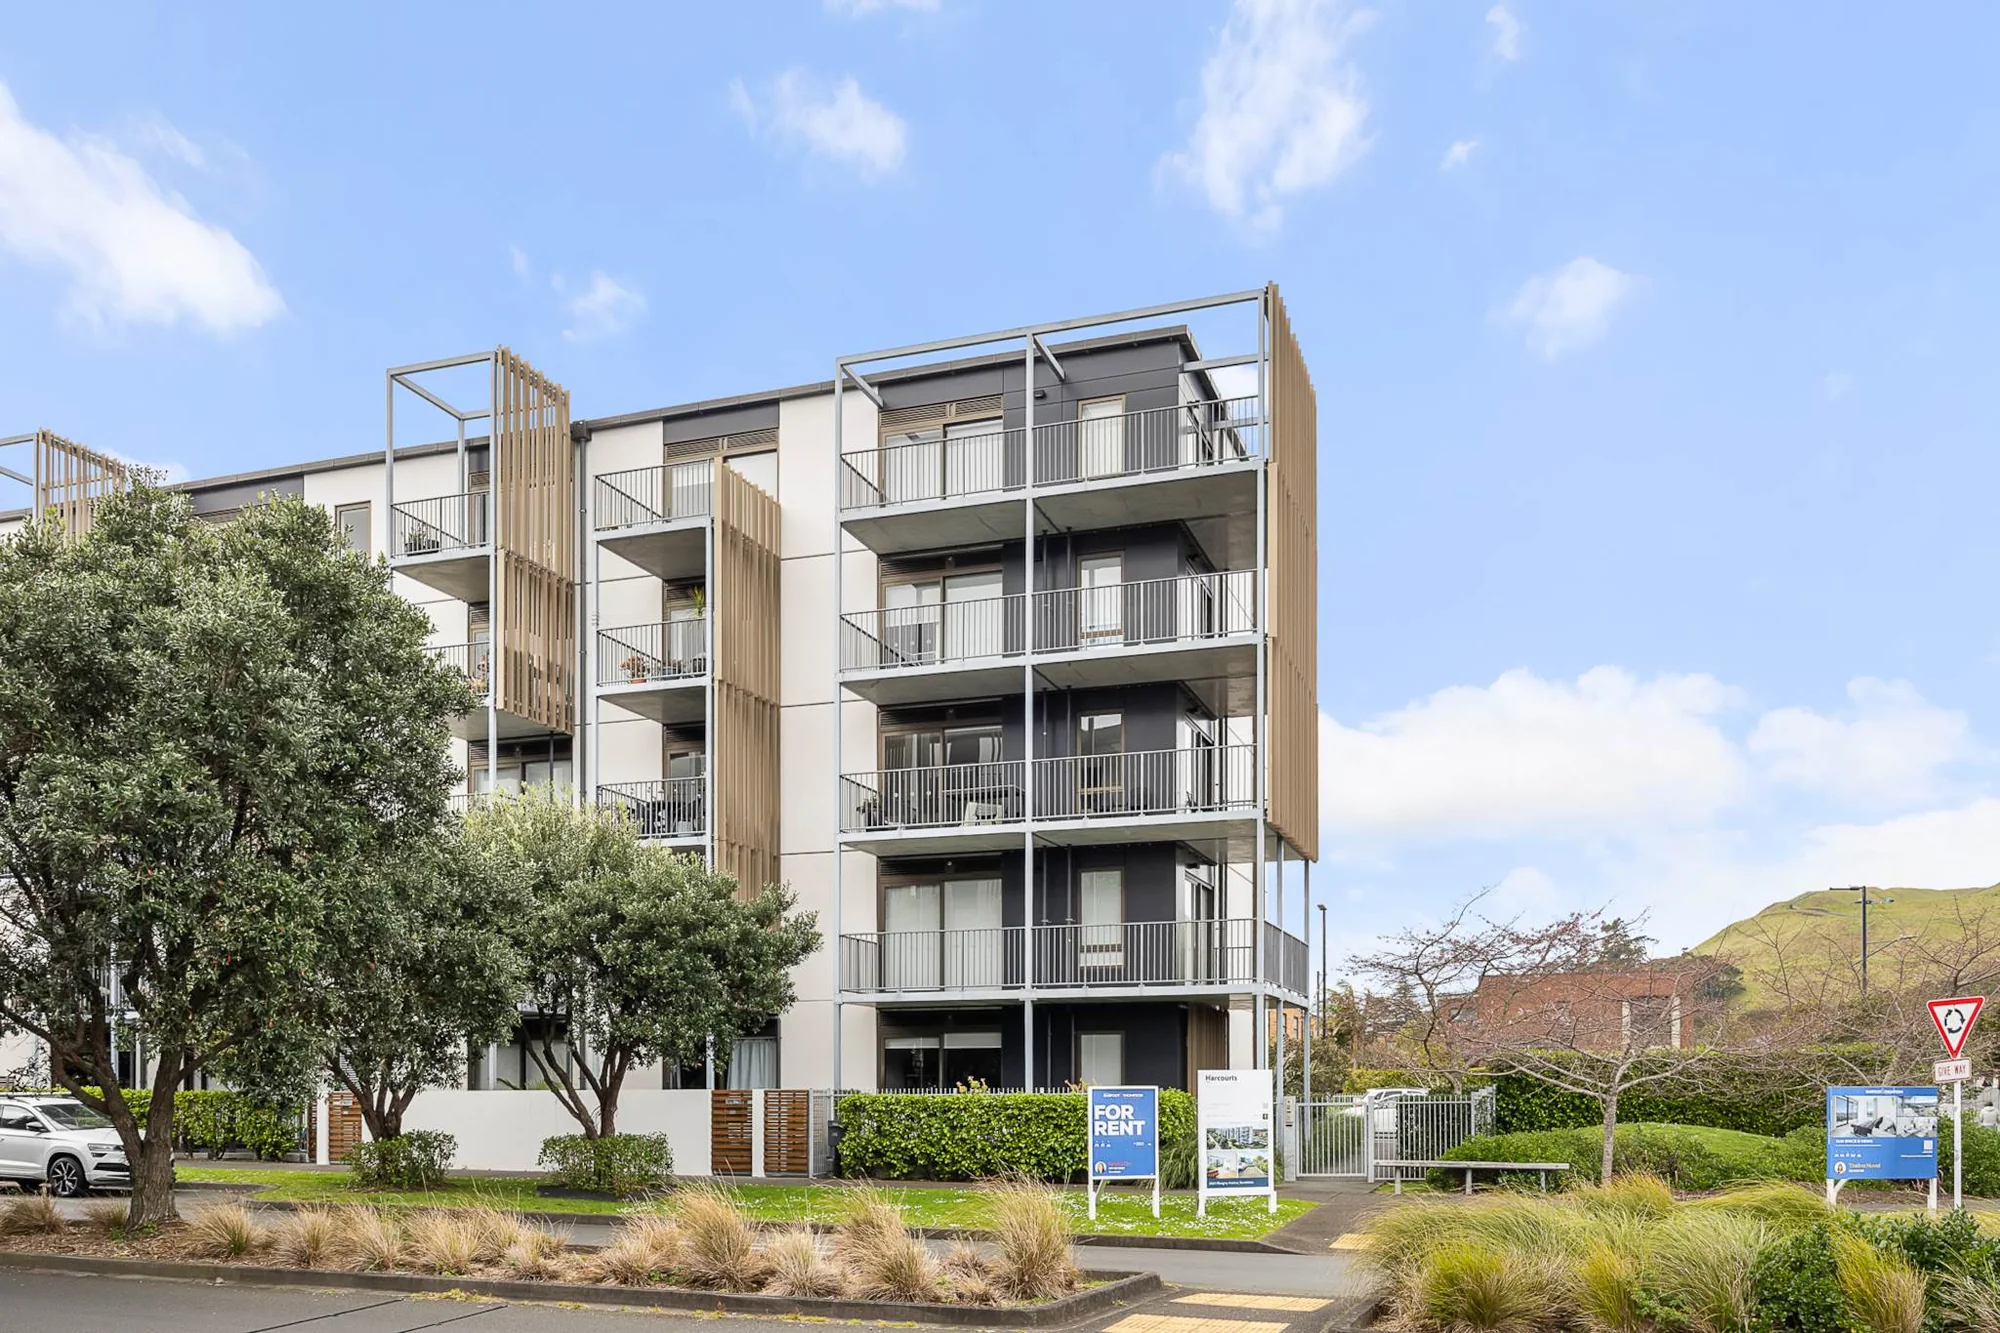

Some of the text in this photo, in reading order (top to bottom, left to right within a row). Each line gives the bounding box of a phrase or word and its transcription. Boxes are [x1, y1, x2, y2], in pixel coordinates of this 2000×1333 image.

[1938, 1064, 1966, 1077] GIVE WAY
[1094, 1104, 1135, 1120] FOR
[1094, 1120, 1145, 1136] RENT
